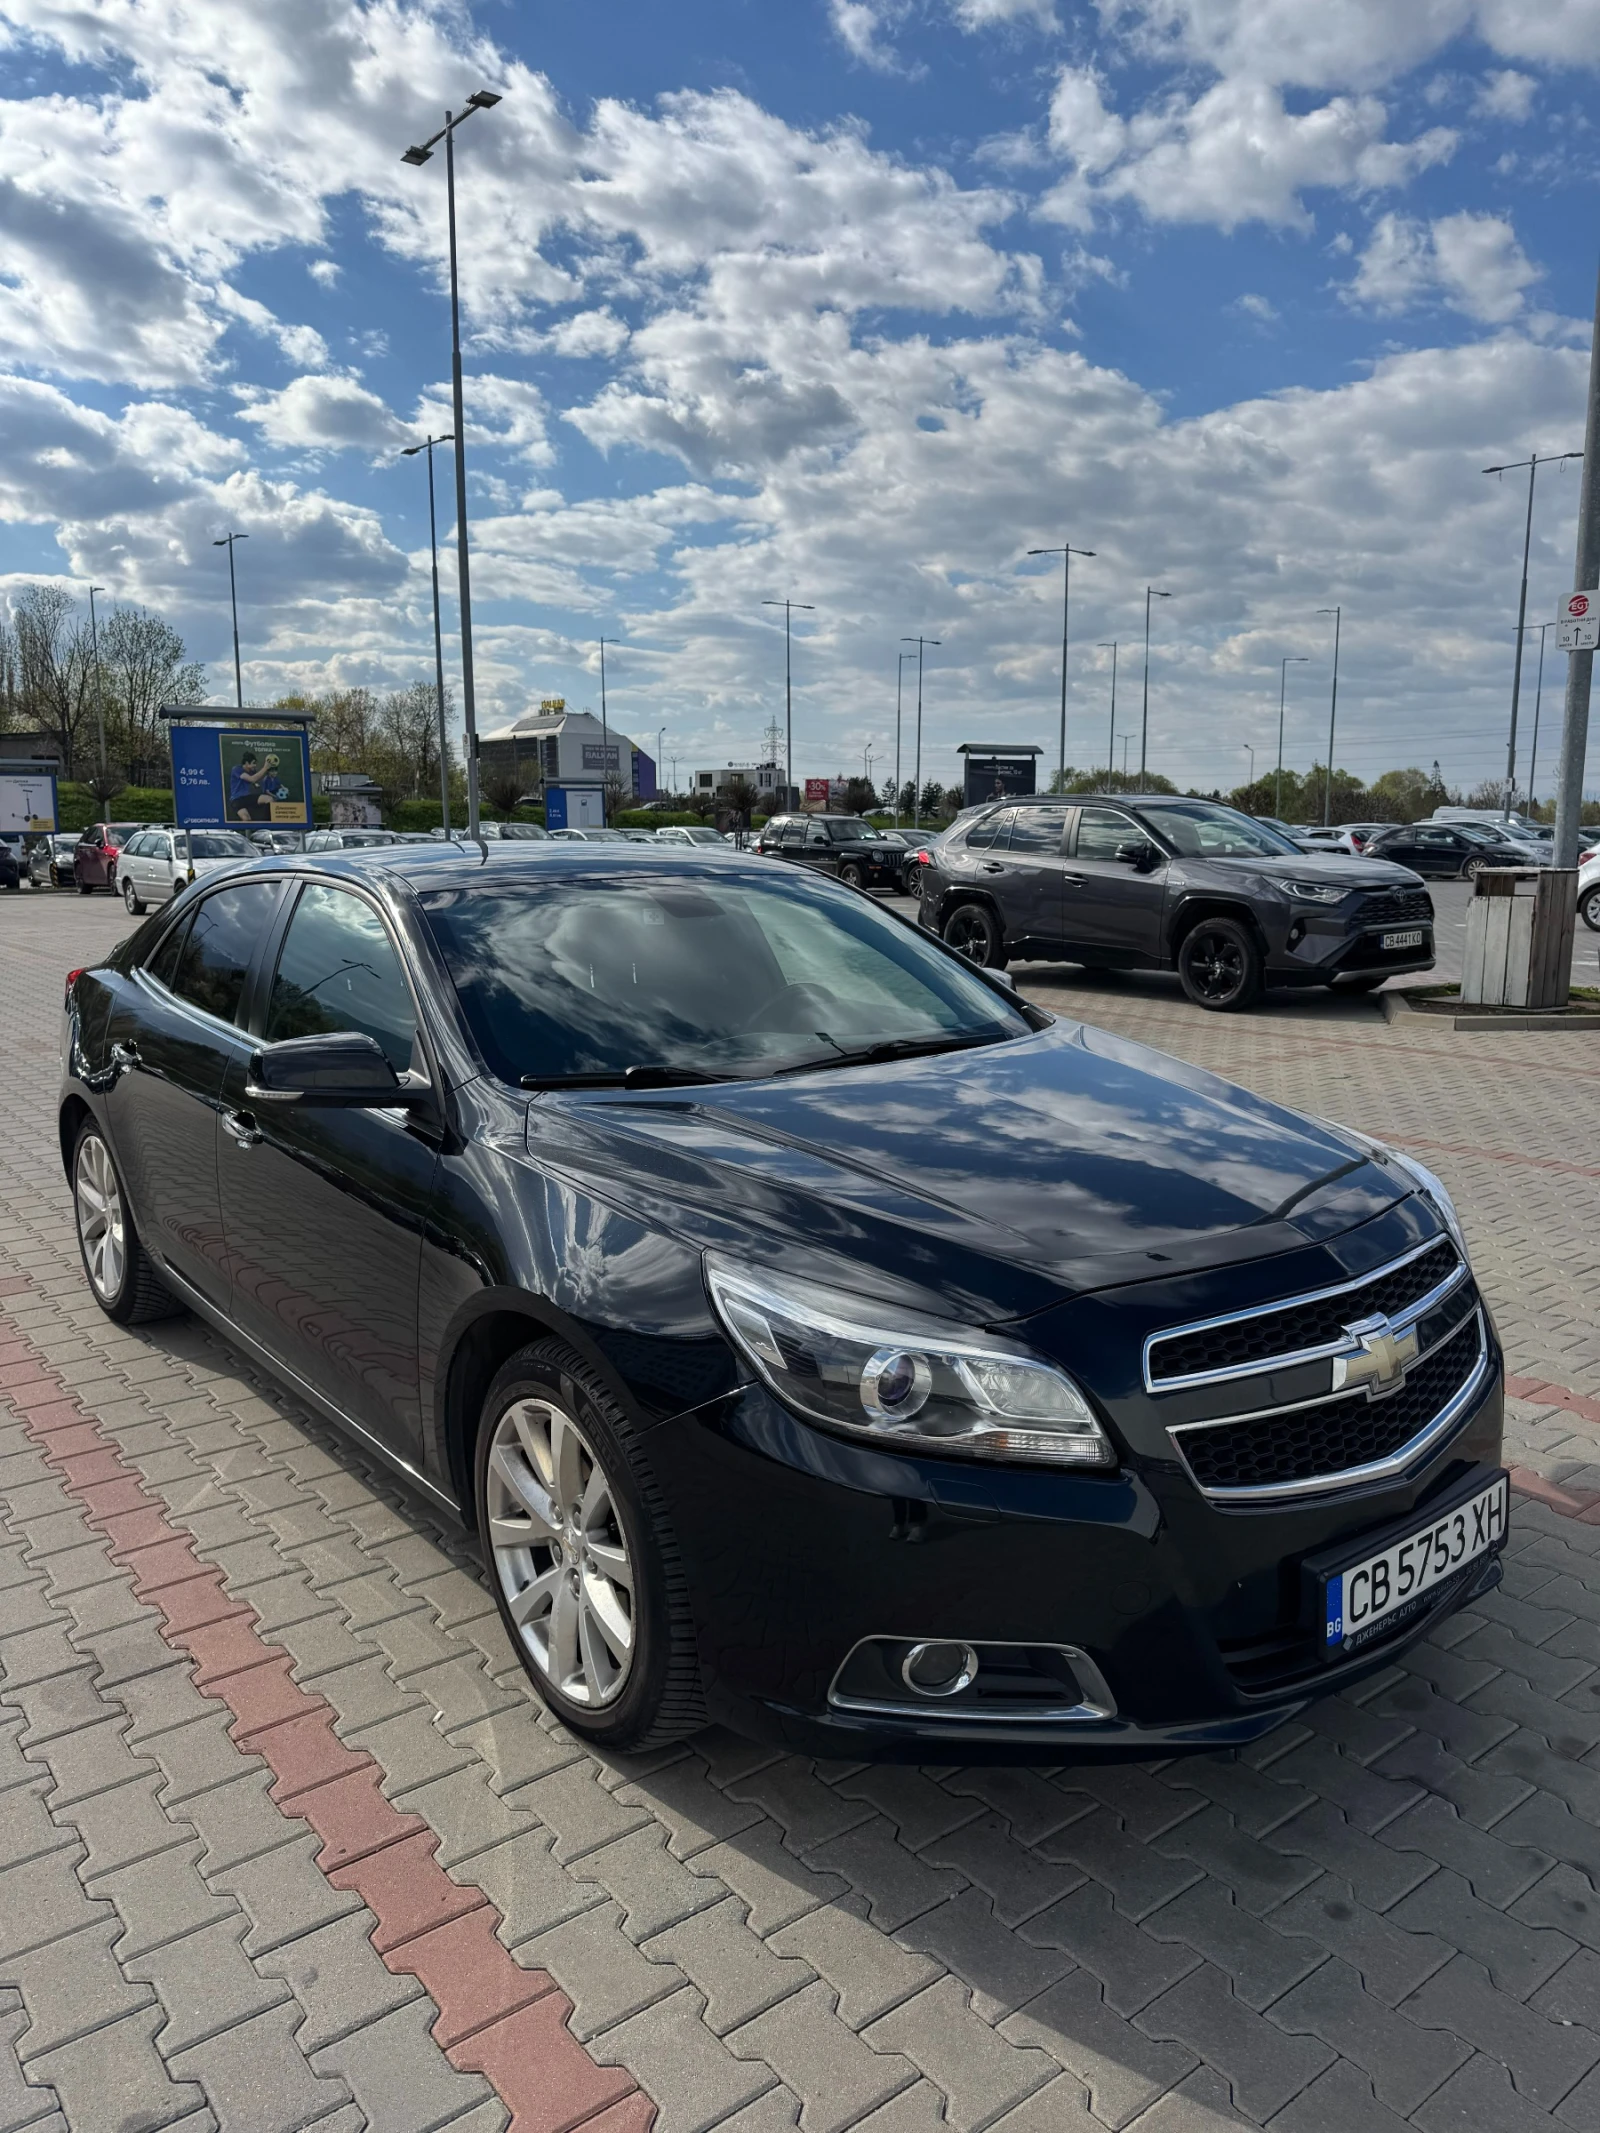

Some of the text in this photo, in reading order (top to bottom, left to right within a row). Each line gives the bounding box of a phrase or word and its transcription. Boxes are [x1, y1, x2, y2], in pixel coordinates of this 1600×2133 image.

[1571, 602, 1589, 610] EGT
[1350, 1558, 1389, 1624] CB
[1398, 1514, 1465, 1597] 5753
[1326, 1618, 1342, 1638] BG
[1355, 1601, 1417, 1647] ДЖЕНЕРЪС АУТО
